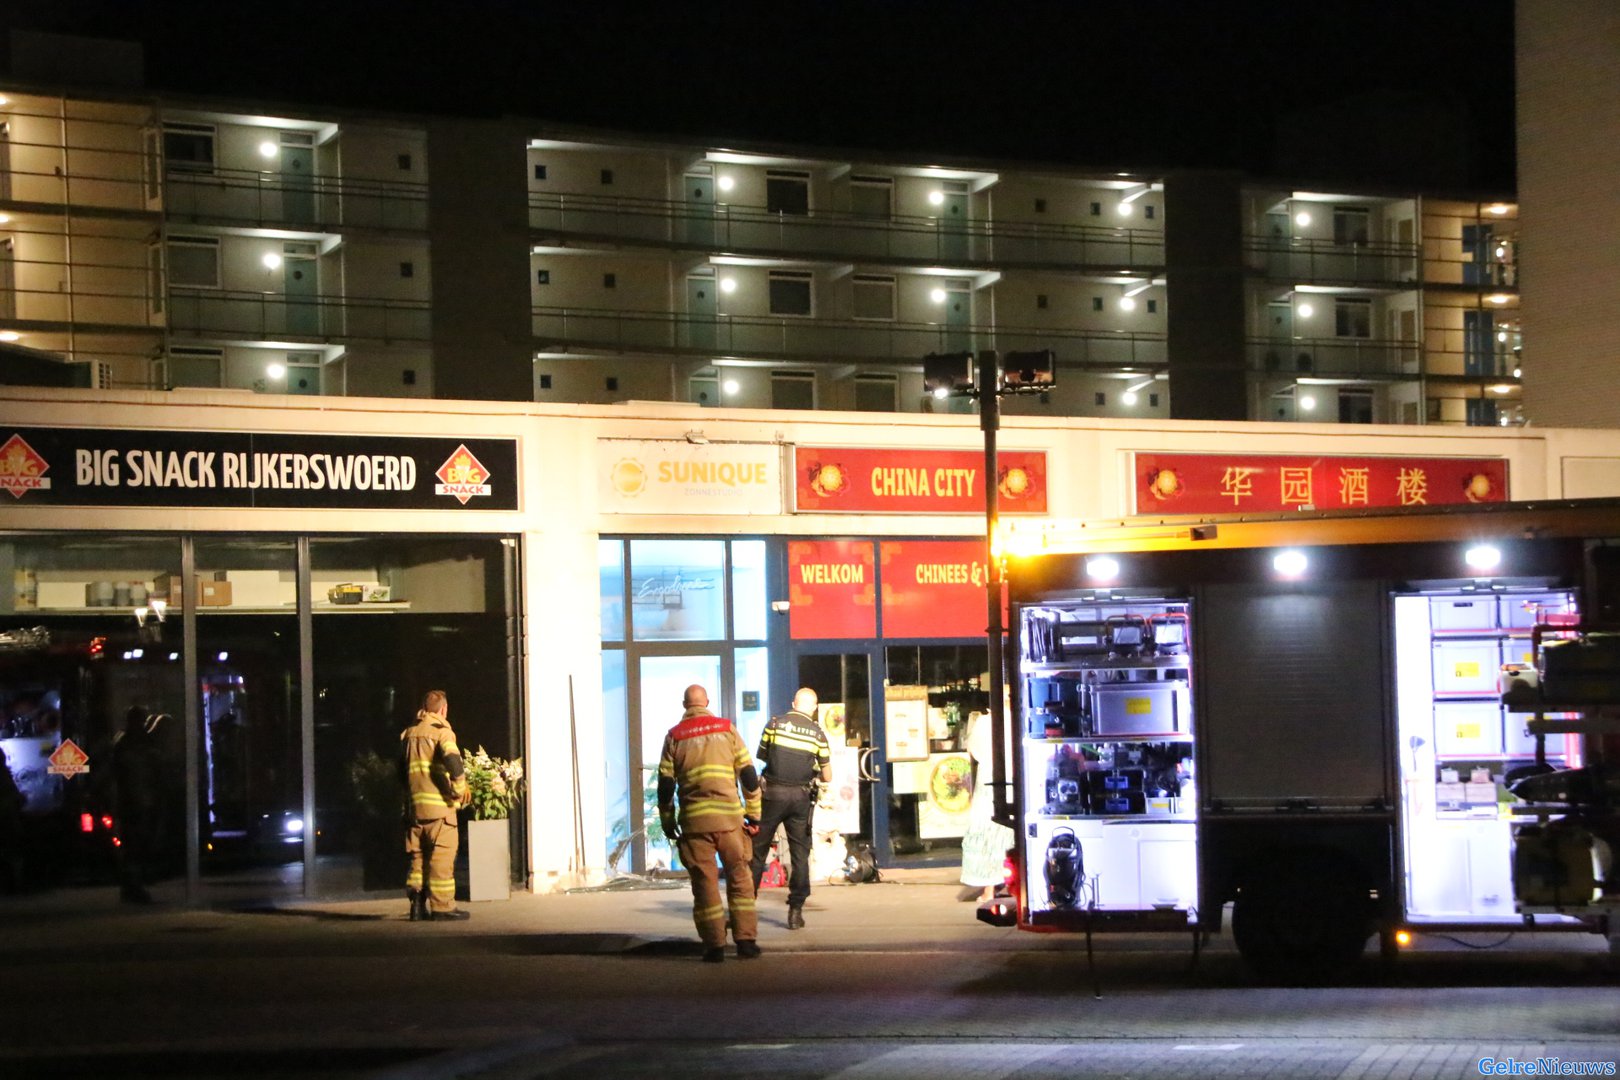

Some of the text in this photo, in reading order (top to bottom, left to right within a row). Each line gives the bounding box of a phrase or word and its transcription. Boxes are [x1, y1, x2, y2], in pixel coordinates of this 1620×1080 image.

[0, 478, 42, 488] NACK
[76, 449, 417, 491] BIG SNACK RIJKERSWOERD
[657, 461, 768, 487] SUNIQUE
[871, 467, 976, 497] CHINA CITY
[442, 485, 484, 494] SNACK
[683, 487, 744, 497] ZONNESTUDIO
[1220, 466, 1428, 506] 华园酒楼
[800, 564, 864, 584] WELKOM
[915, 564, 968, 584] CHINEES
[971, 561, 983, 587] &
